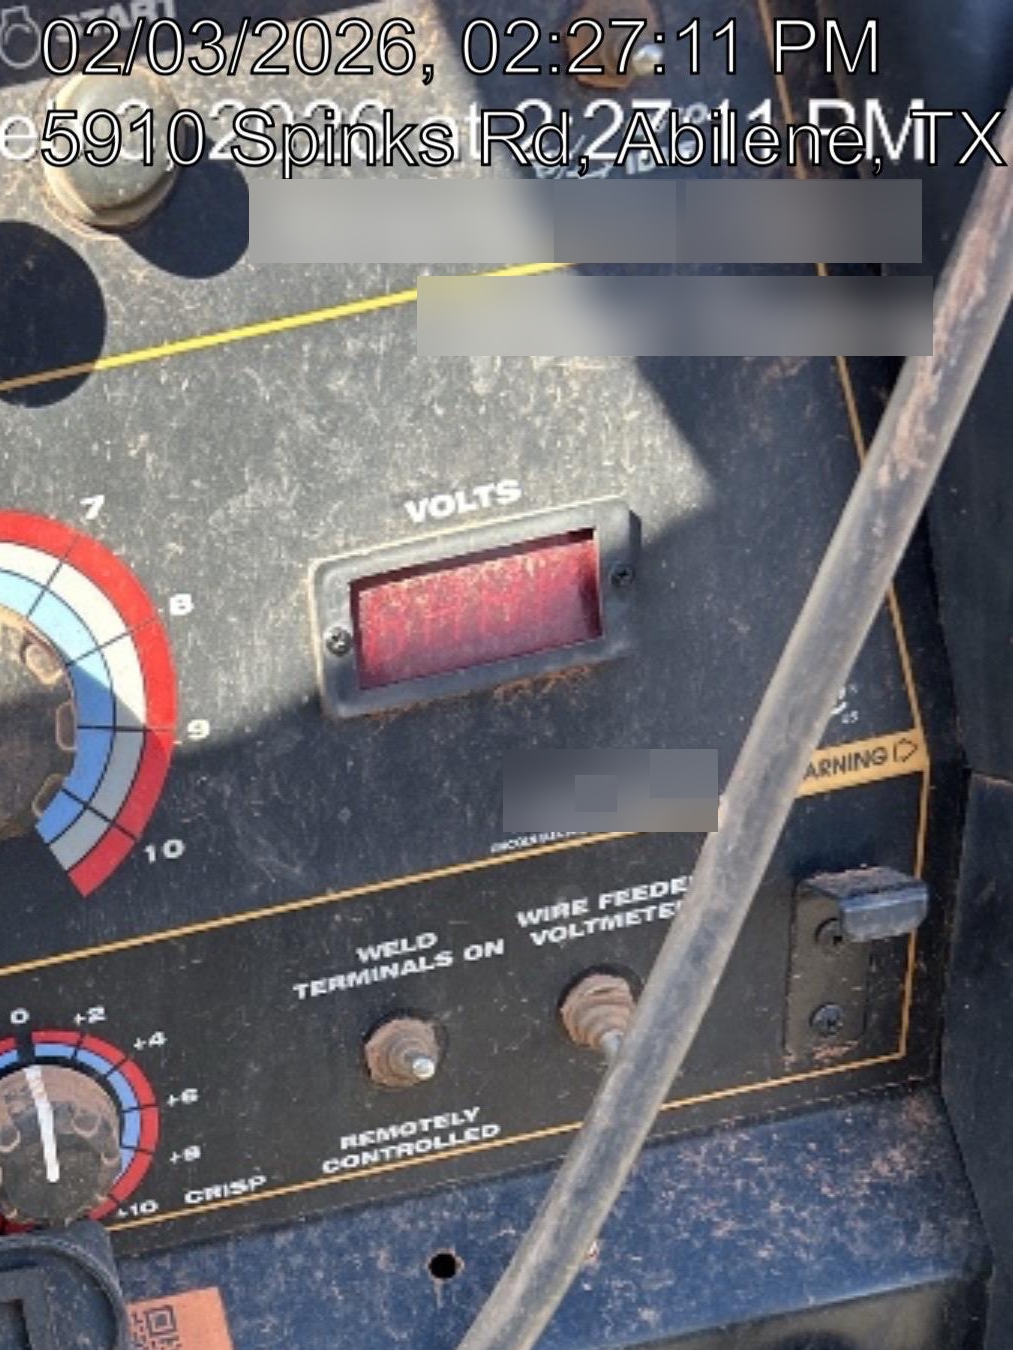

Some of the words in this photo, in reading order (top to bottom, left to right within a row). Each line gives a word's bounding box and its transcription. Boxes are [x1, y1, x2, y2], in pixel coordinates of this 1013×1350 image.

[80, 495, 105, 519] 7
[405, 479, 523, 523] VOLTS
[170, 594, 193, 616] 8
[188, 720, 210, 740] 9
[803, 746, 889, 780] ARNING
[145, 840, 185, 863] 10
[516, 896, 589, 928] WIRE
[598, 875, 694, 910] FEEDE
[529, 900, 685, 946] VOLTMETE
[357, 932, 437, 964] WELD
[293, 952, 453, 1001] TERMINALS
[463, 939, 505, 964] ON
[10, 1008, 29, 1025] 0
[73, 1006, 108, 1026] +2
[133, 1030, 168, 1052] +4
[340, 1106, 481, 1151] REMOTELY
[321, 1123, 502, 1175] CONTROLLED
[185, 1174, 267, 1206] CRISP
